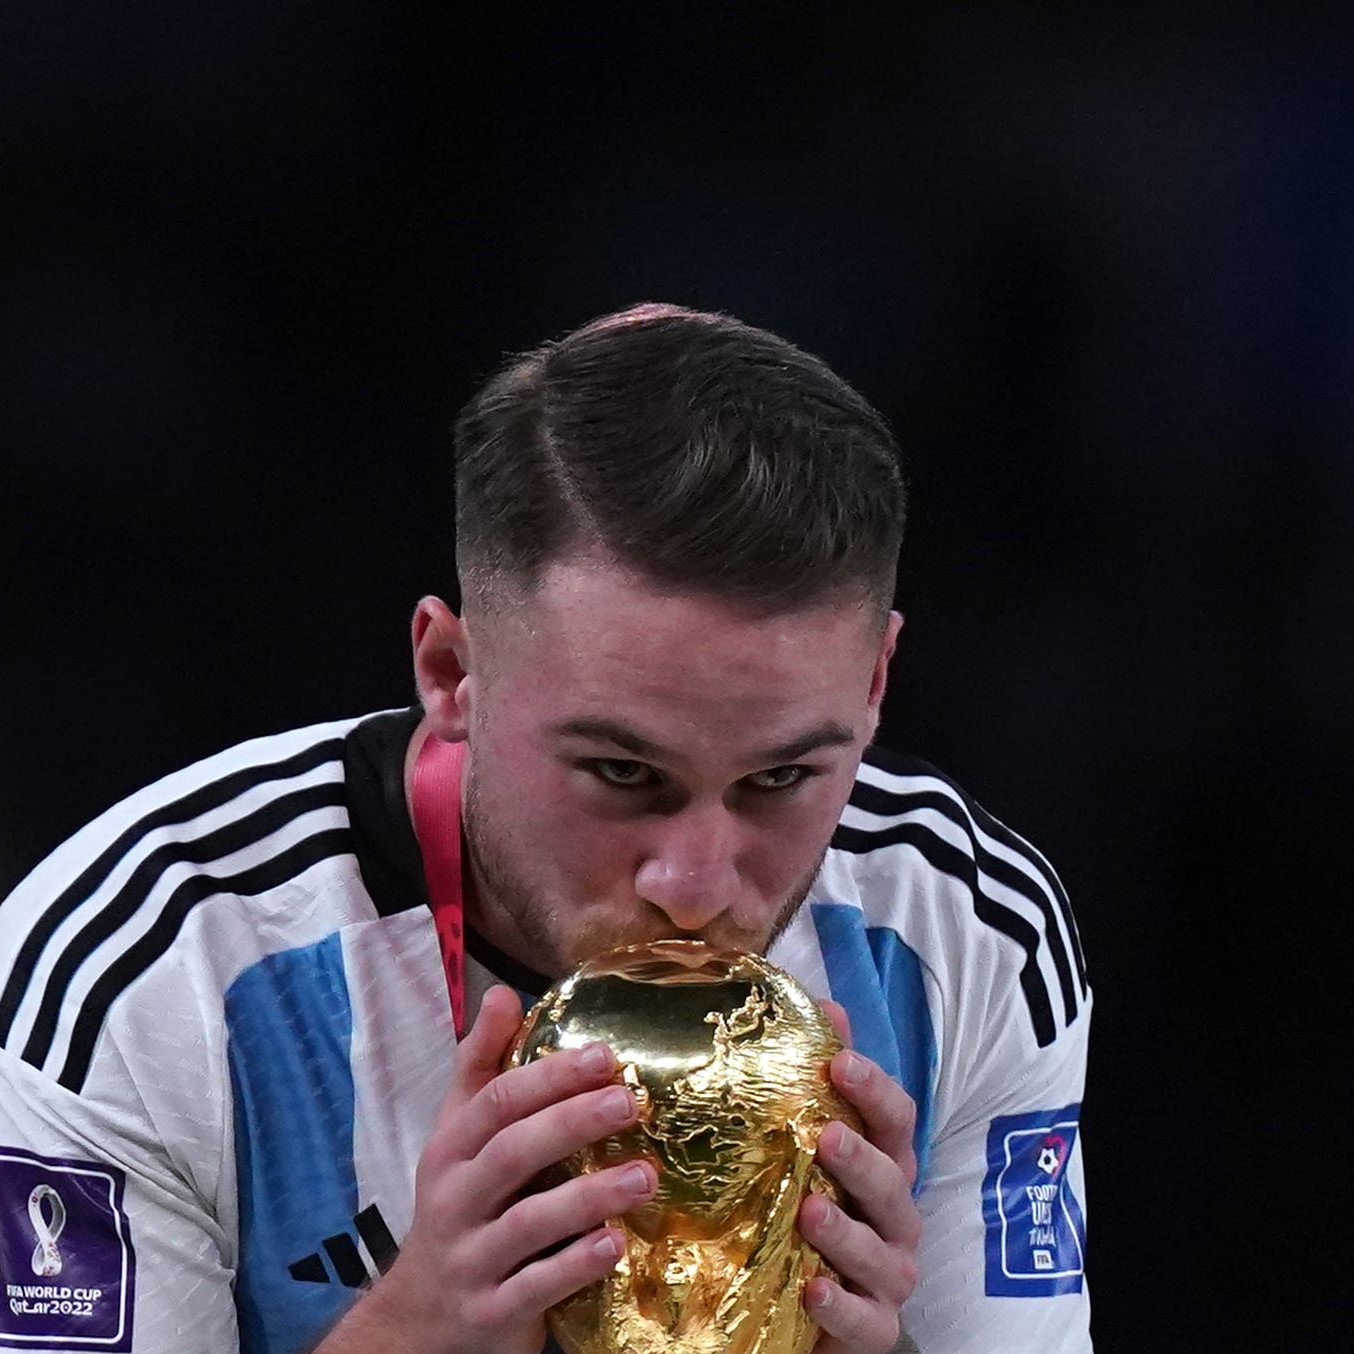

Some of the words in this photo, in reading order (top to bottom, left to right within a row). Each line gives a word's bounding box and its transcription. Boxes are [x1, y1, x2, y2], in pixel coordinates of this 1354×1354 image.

[7, 1284, 24, 1298] FIFA
[24, 1286, 72, 1299] WORLD
[73, 1288, 102, 1301] CUP
